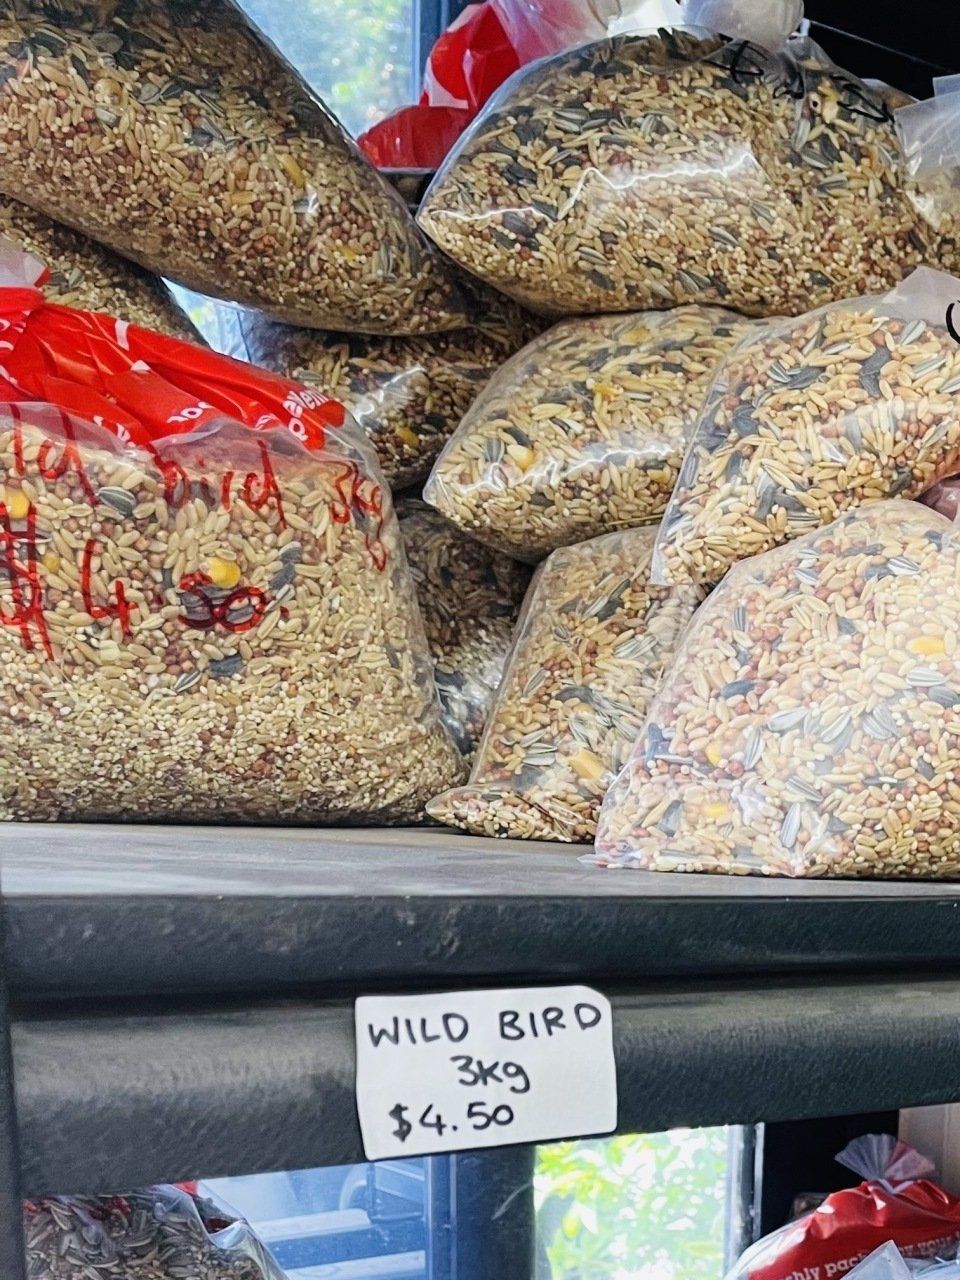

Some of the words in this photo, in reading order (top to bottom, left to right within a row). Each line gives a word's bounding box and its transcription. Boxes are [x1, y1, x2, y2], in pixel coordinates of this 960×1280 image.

[368, 1013, 469, 1047] WILD
[499, 1003, 601, 1040] BIRD
[389, 1101, 514, 1142] $4.50
